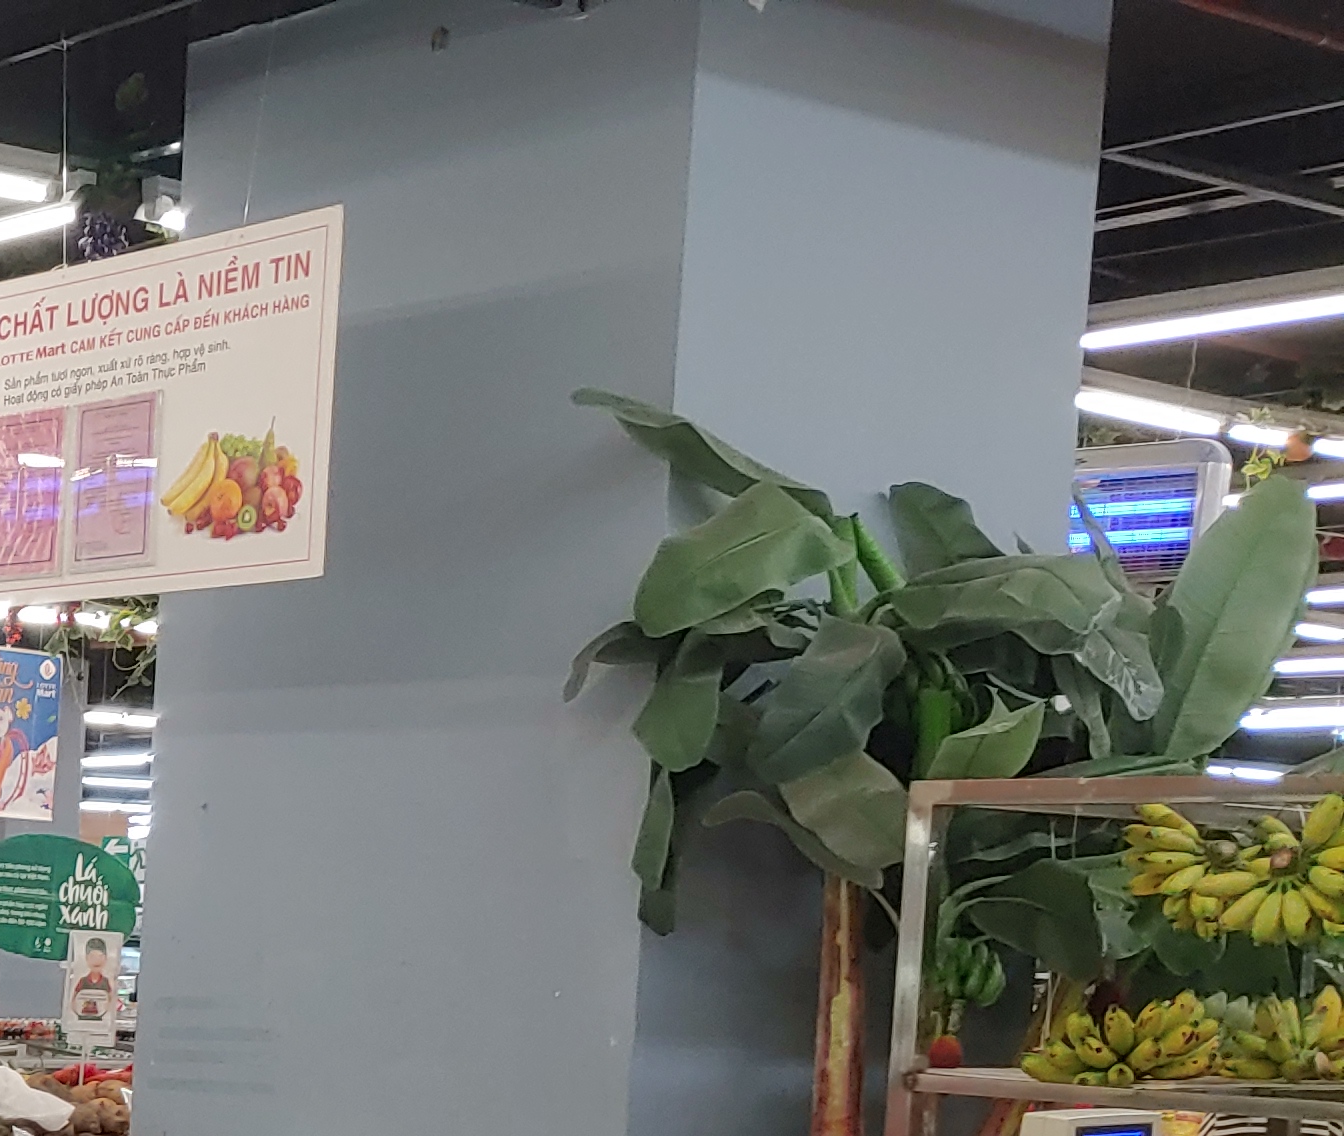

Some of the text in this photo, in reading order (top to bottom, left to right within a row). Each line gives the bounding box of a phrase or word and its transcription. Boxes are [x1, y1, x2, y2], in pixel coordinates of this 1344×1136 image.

[66, 287, 148, 327] LƯỢNG
[159, 272, 188, 308] LÀ
[269, 250, 311, 286] TIN
[35, 343, 67, 360] Mart
[70, 333, 96, 354] CAM
[99, 328, 123, 349] KẾT
[126, 324, 161, 343] CUNG
[165, 314, 190, 337] CẤP
[193, 309, 220, 330] ĐẾN
[223, 303, 268, 325] KHÁCH
[272, 294, 310, 314] HÀNG
[51, 388, 62, 398] có
[110, 375, 123, 387] An
[126, 369, 149, 385] Toàn
[151, 366, 176, 380] Thực
[178, 359, 206, 375] Phẩm
[37, 689, 56, 698] Mart
[74, 852, 98, 882] Lá
[59, 876, 109, 906] chuối
[59, 904, 109, 929] xanh
